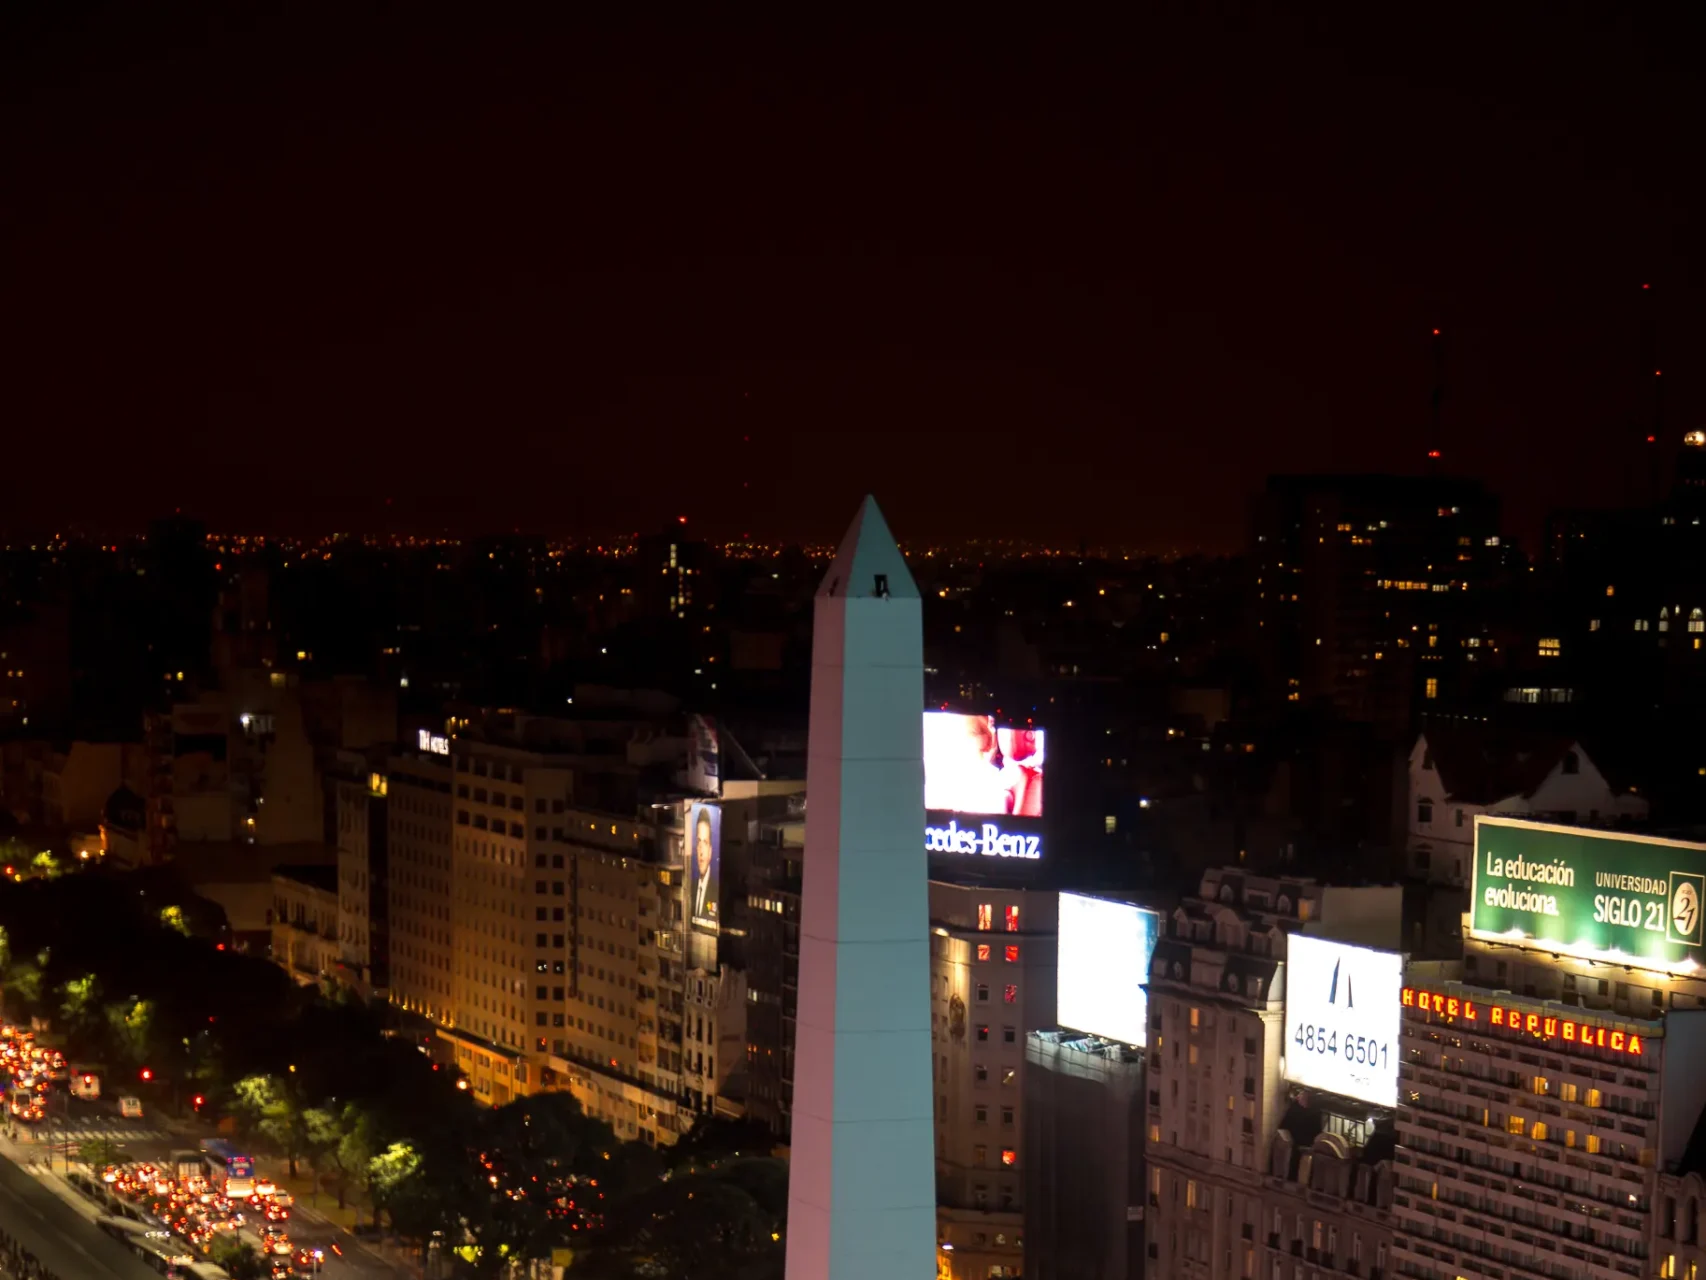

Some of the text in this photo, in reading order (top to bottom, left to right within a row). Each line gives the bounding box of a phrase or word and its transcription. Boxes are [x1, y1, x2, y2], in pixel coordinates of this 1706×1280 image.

[925, 820, 1040, 859] cedes-Benz
[1486, 851, 1574, 887] La educación
[1595, 872, 1667, 896] UNIVERSIDAD
[1485, 884, 1559, 917] evoluciona.
[1593, 895, 1666, 932] SIGLO 21
[1402, 987, 1643, 1055] HOTEL REPUBLICA
[1295, 1022, 1388, 1070] 4854 6501
